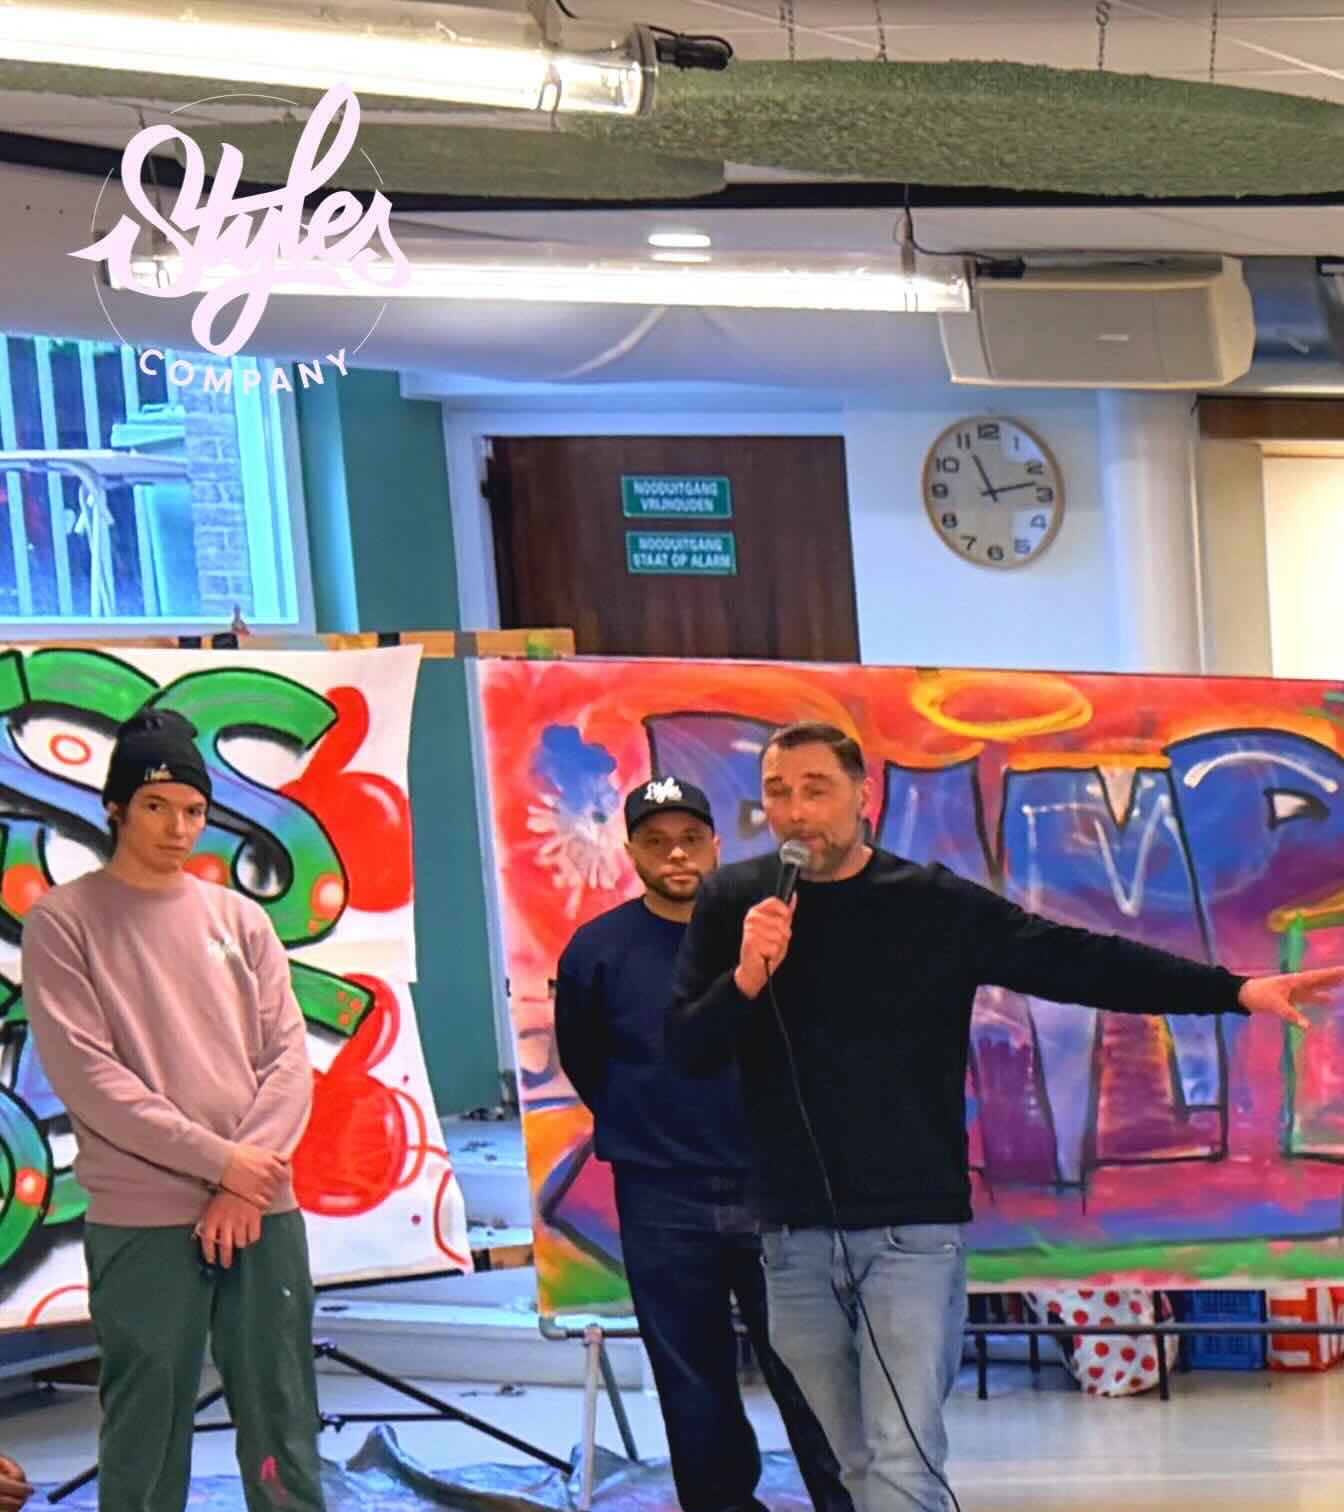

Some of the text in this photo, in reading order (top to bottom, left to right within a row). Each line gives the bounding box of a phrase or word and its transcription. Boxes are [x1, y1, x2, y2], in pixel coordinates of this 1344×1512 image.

[977, 423, 1000, 441] 12
[956, 433, 971, 449] 11
[936, 456, 960, 473] 10
[1026, 459, 1044, 475] 2
[931, 483, 949, 499] 9
[1035, 487, 1054, 503] 3
[941, 512, 958, 529] 8
[1029, 514, 1047, 530] 4
[960, 535, 978, 551] 7
[1013, 539, 1031, 555] 5
[987, 545, 1004, 561] 6
